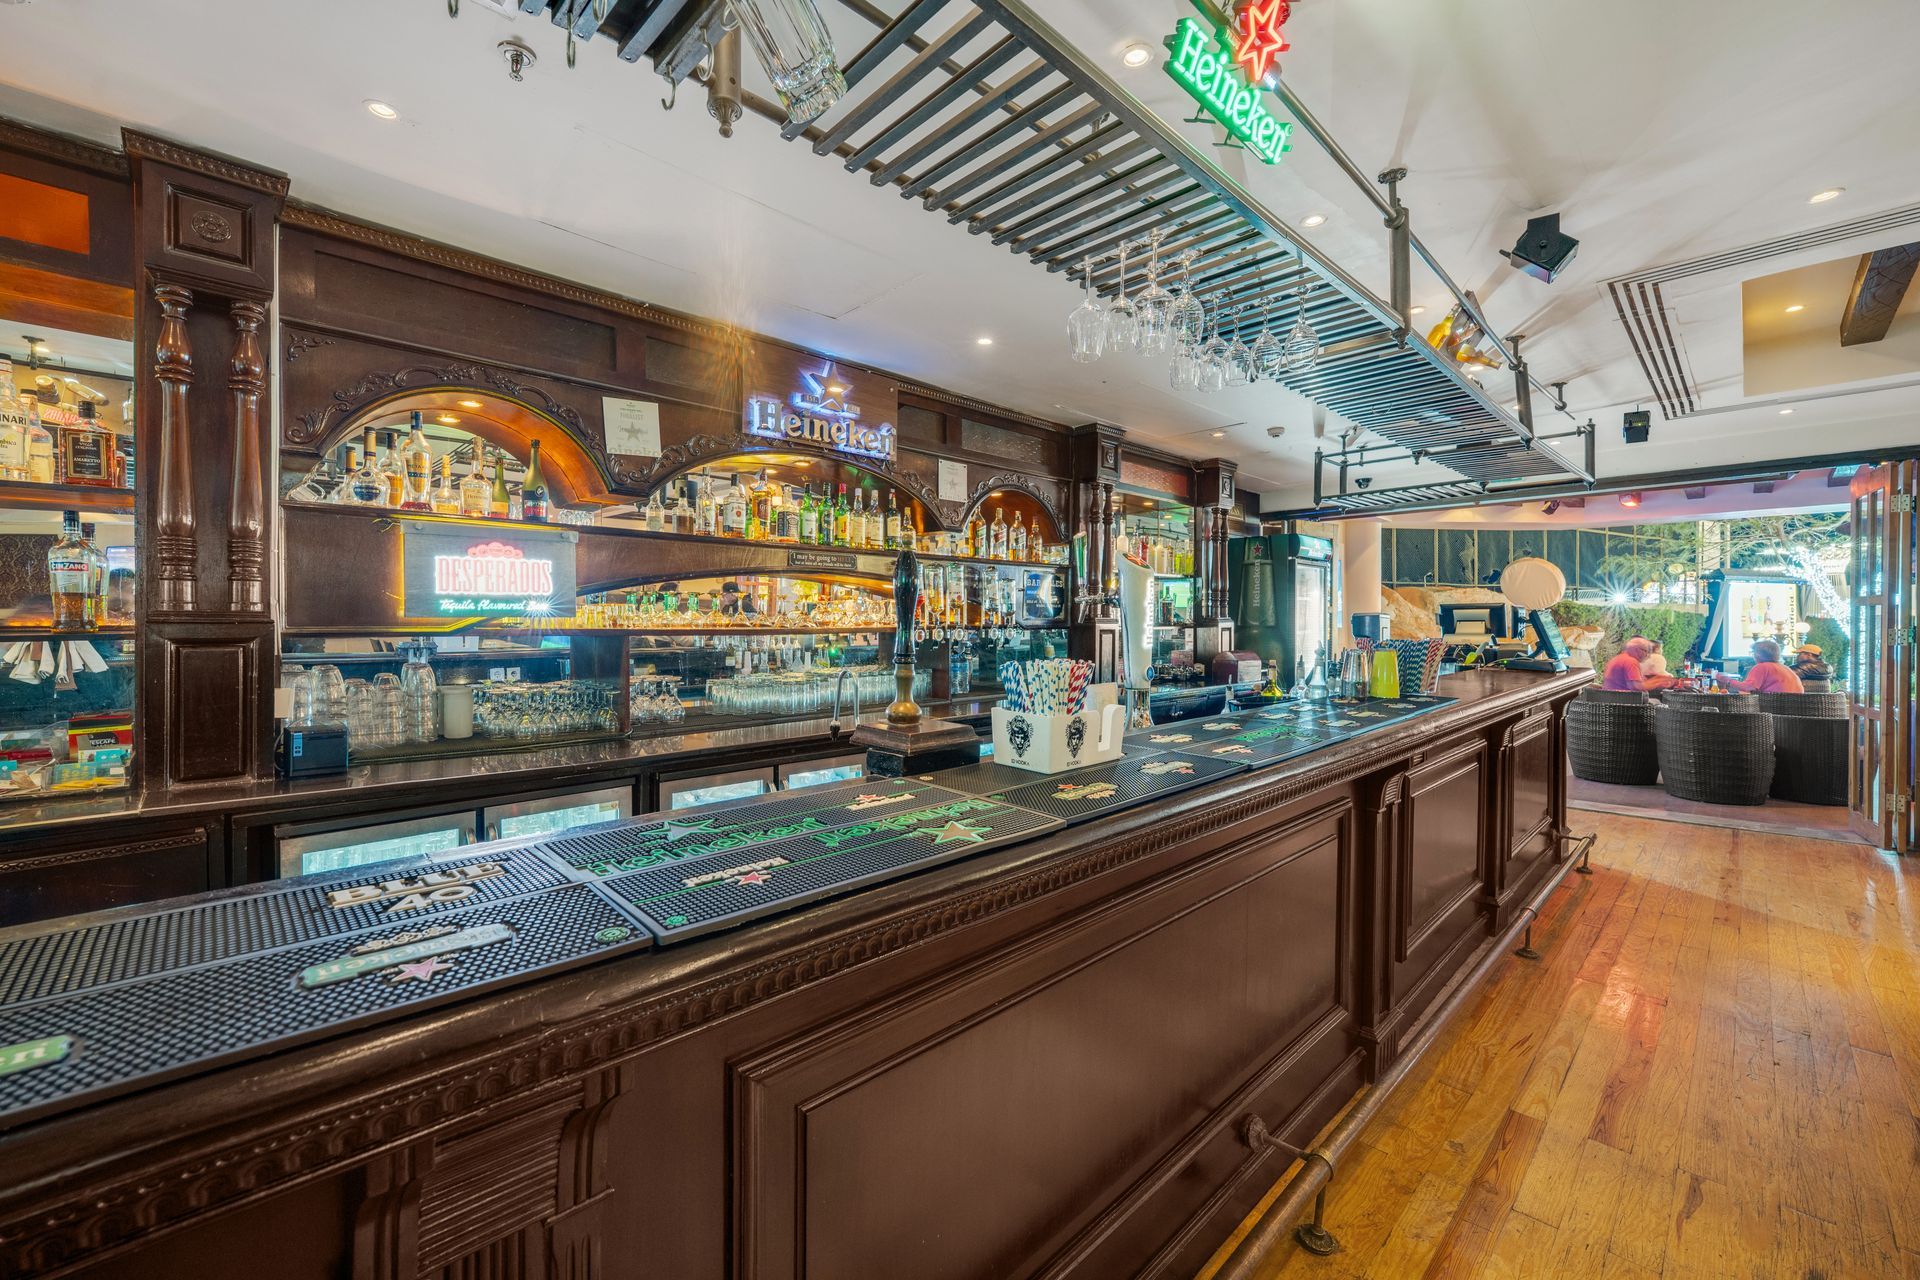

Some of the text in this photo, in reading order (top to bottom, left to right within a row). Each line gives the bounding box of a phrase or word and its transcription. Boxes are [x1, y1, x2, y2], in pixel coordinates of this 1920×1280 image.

[1174, 19, 1288, 163] Heineken
[754, 398, 896, 457] Heineken
[51, 562, 87, 570] CINZANO
[437, 556, 552, 594] DESPERADOS
[808, 553, 816, 561] be
[817, 554, 831, 562] going
[1252, 560, 1261, 607] Heineken
[440, 599, 475, 613] Tequila
[575, 817, 832, 877] Heineken
[327, 861, 506, 908] BLUE
[382, 884, 479, 913] 40
